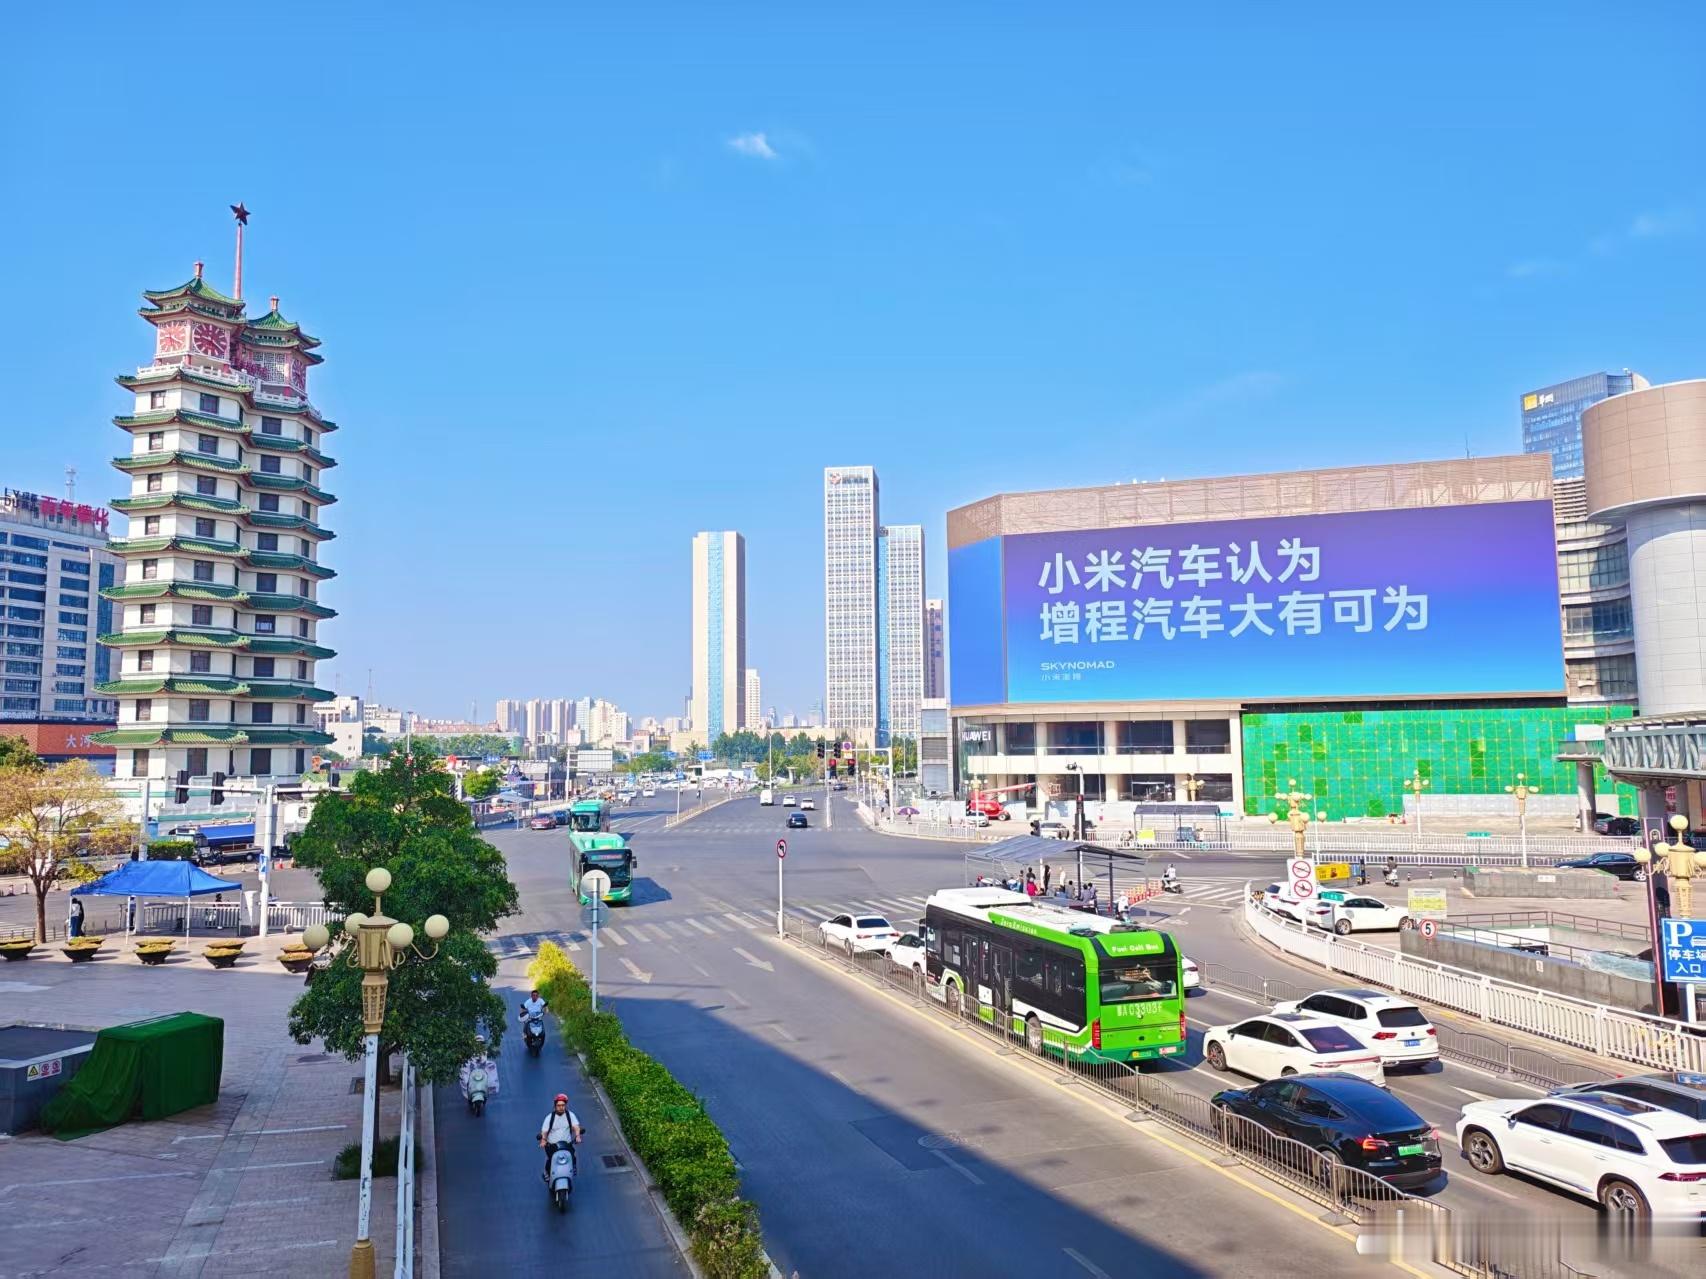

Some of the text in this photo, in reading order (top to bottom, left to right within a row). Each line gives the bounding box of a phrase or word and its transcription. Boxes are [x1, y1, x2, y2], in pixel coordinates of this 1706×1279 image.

[1038, 537, 1321, 594] 小米汽车认为
[1040, 585, 1428, 645] 增程汽车大有可为
[1040, 661, 1115, 671] SKYNOMAD
[961, 731, 991, 741] HUAWEI
[1425, 923, 1432, 935] 5
[1666, 921, 1692, 947] P
[1675, 962, 1701, 973] 入口
